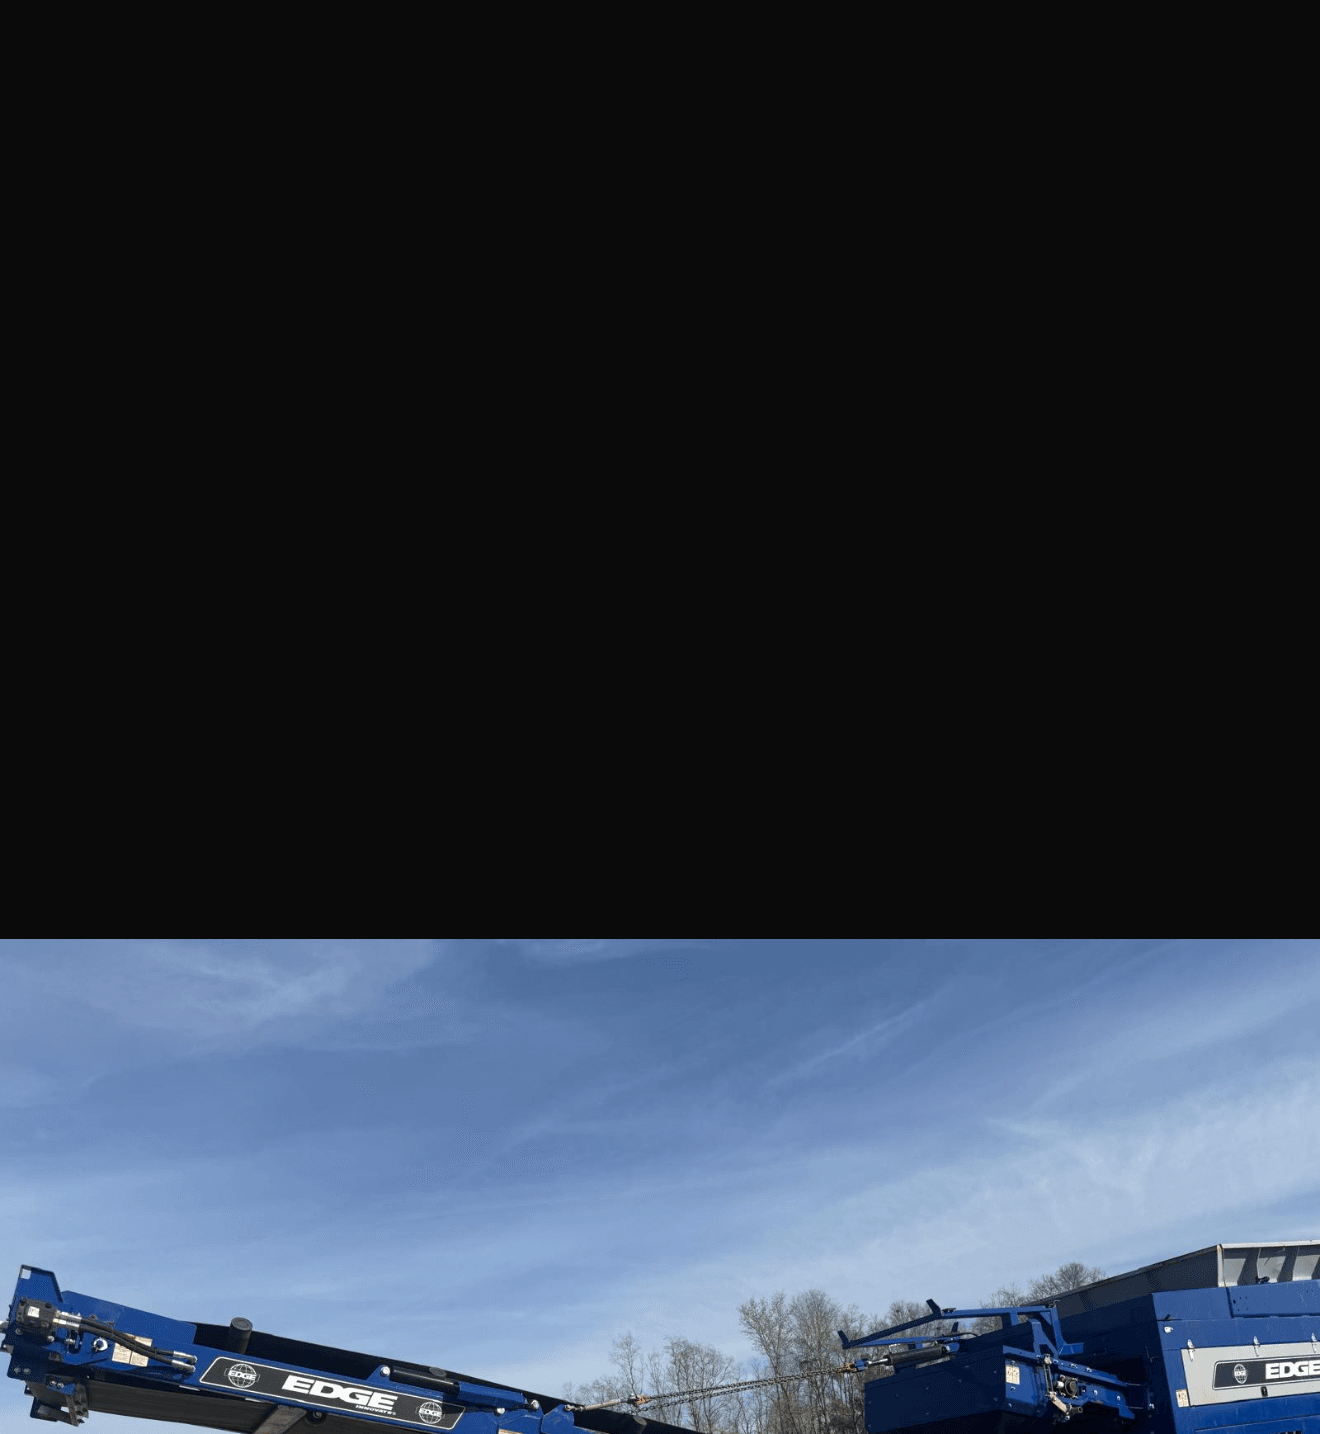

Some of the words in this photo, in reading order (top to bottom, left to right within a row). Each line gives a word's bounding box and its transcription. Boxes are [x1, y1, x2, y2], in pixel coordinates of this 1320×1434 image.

[228, 1370, 257, 1381] EDGE
[1265, 1360, 1320, 1380] EDGE
[281, 1374, 399, 1411] EDGE
